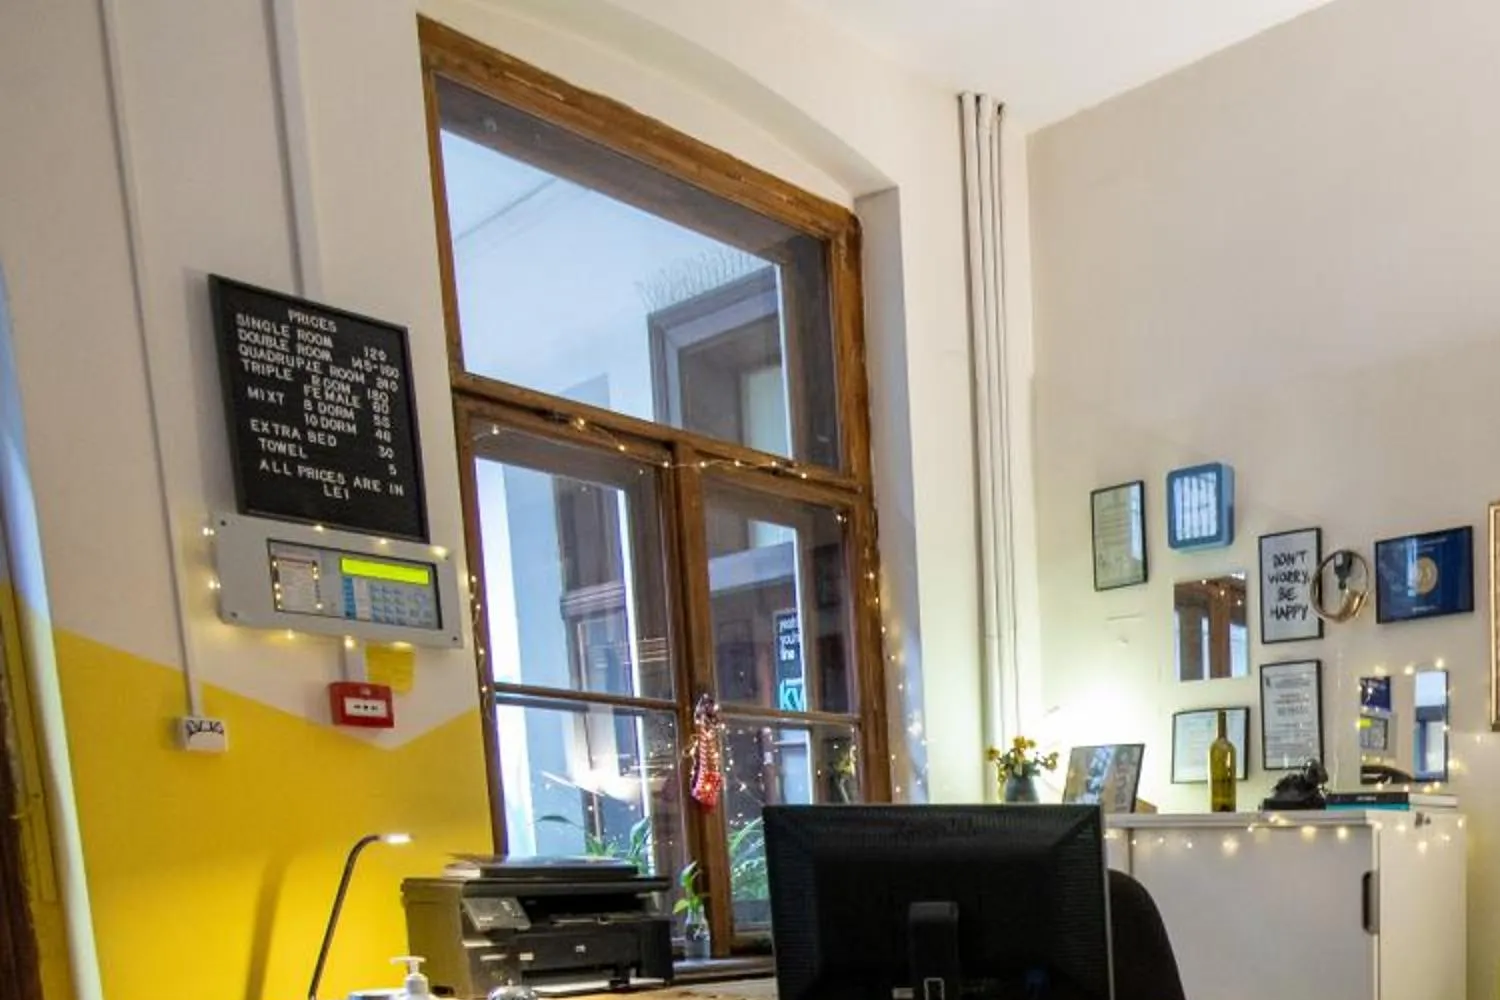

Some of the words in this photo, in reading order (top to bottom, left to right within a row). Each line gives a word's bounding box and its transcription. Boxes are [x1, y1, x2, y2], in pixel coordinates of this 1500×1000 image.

[236, 312, 290, 338] SINGLE
[296, 328, 334, 348] ROOM
[288, 309, 337, 333] PRICES
[237, 328, 290, 353] DOUBLE
[296, 343, 333, 362] ROOM
[238, 343, 322, 374] QUADRUPLE
[329, 364, 365, 384] ROOM
[241, 358, 294, 381] TRIPLE
[311, 374, 351, 394] ROOM
[247, 386, 285, 406] MIXT
[317, 401, 355, 420] DORM
[249, 418, 302, 441] EXTRA
[307, 431, 337, 447] BED
[304, 413, 318, 428] 10
[320, 416, 357, 436] DORM
[257, 437, 309, 459] TOWEL
[388, 463, 397, 476] 5
[259, 459, 293, 476] ALL
[297, 465, 346, 485] PRICES
[353, 476, 382, 493] ARE
[389, 483, 405, 497] IN
[323, 484, 349, 500] LEI
[1273, 550, 1308, 568] DON'T
[1278, 586, 1297, 602] BE
[1270, 603, 1309, 621] HAPPY
